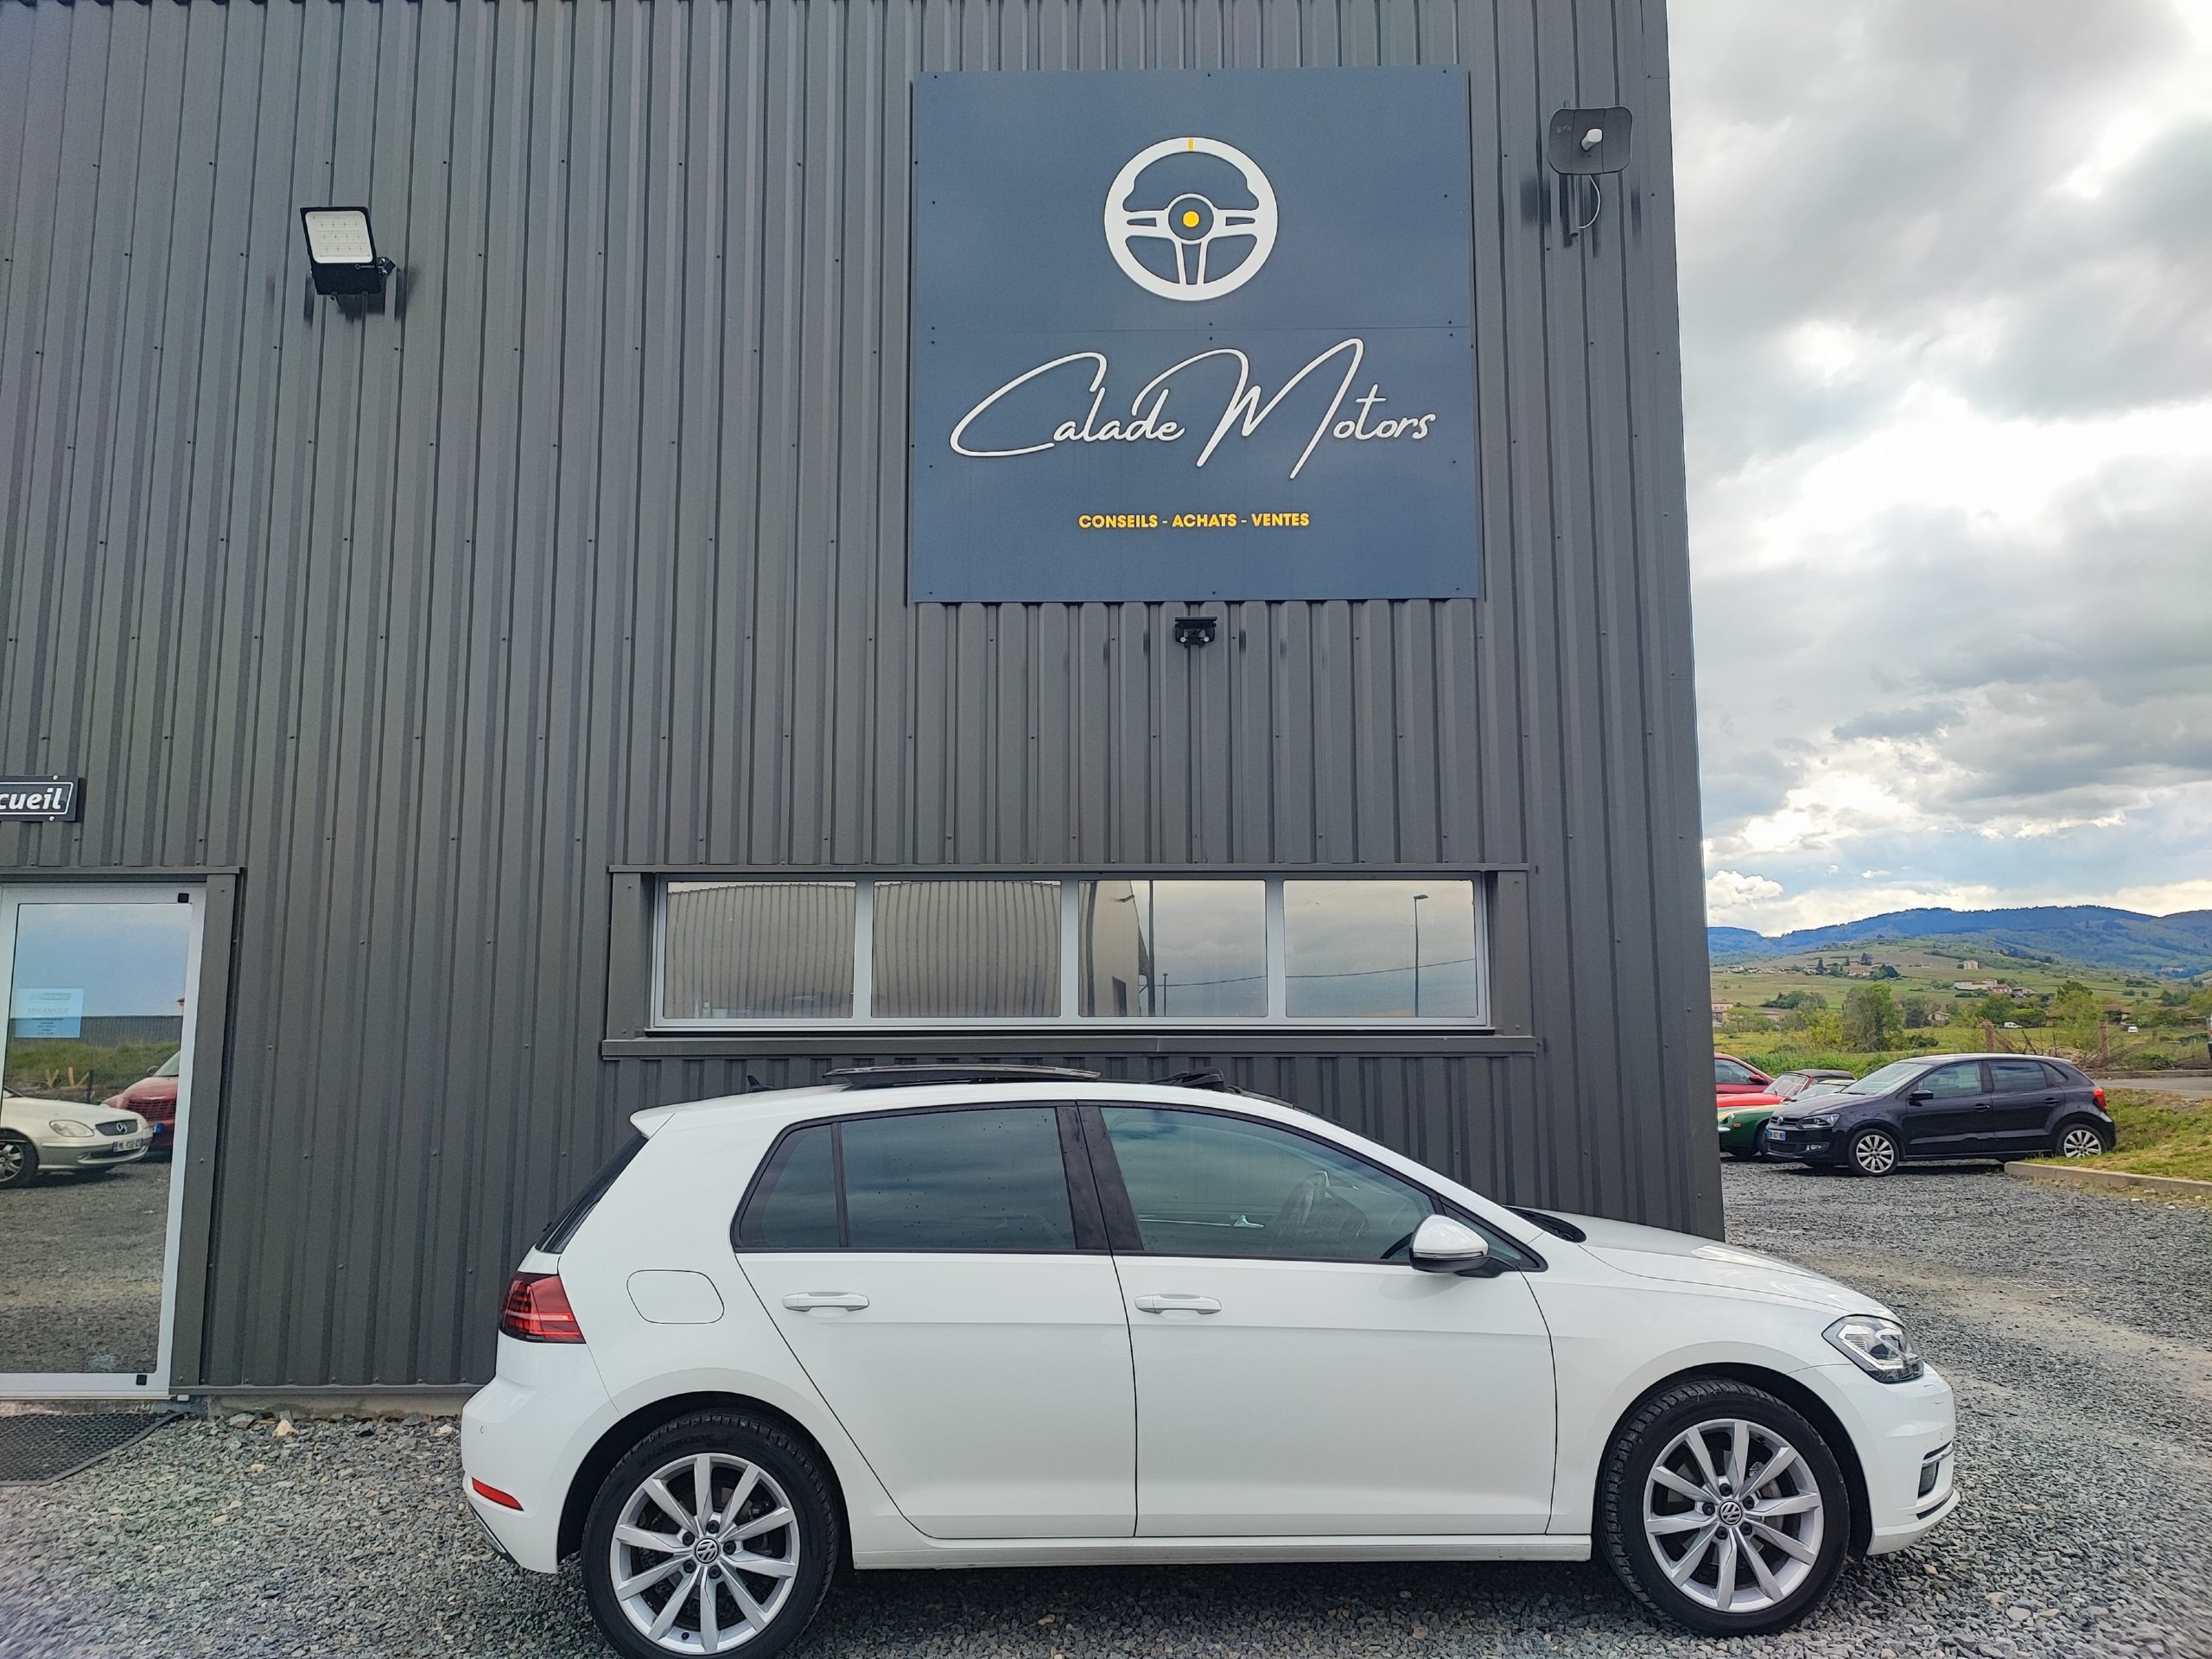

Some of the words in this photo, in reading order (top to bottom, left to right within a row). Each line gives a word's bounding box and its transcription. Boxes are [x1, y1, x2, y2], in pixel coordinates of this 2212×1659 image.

[950, 352, 1185, 457] Calade
[1132, 338, 1437, 479] Motors
[1077, 514, 1159, 529] CONSEILS
[1172, 513, 1237, 528] ACHATS
[1251, 512, 1310, 527] VENTES
